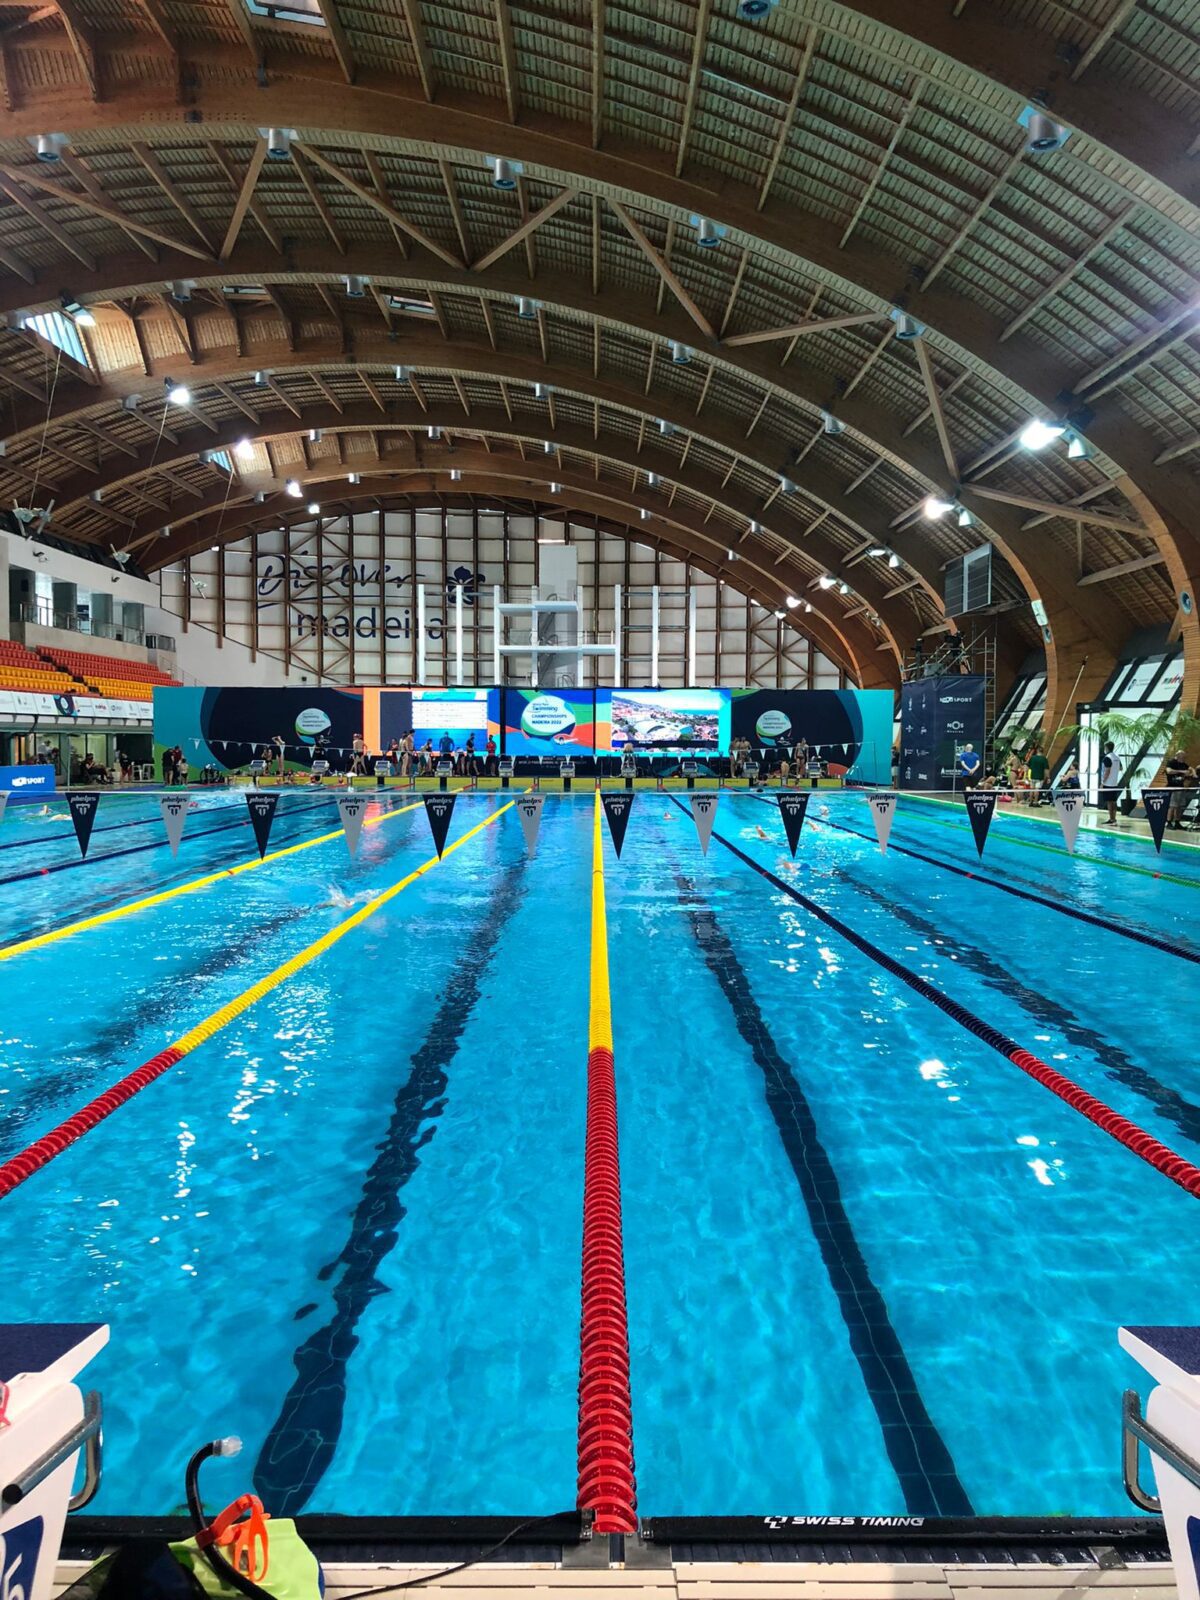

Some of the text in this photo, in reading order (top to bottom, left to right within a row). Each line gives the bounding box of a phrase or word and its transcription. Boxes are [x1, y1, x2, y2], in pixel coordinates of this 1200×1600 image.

[946, 721, 964, 730] NOS
[70, 795, 97, 803] phelps
[161, 796, 188, 804] phelps
[249, 796, 276, 804] phelps
[426, 797, 453, 805] phelps
[780, 795, 806, 803] phelps
[869, 794, 896, 802] phelps
[967, 795, 994, 803] phelps
[791, 1516, 925, 1527] SWISS TIMING
